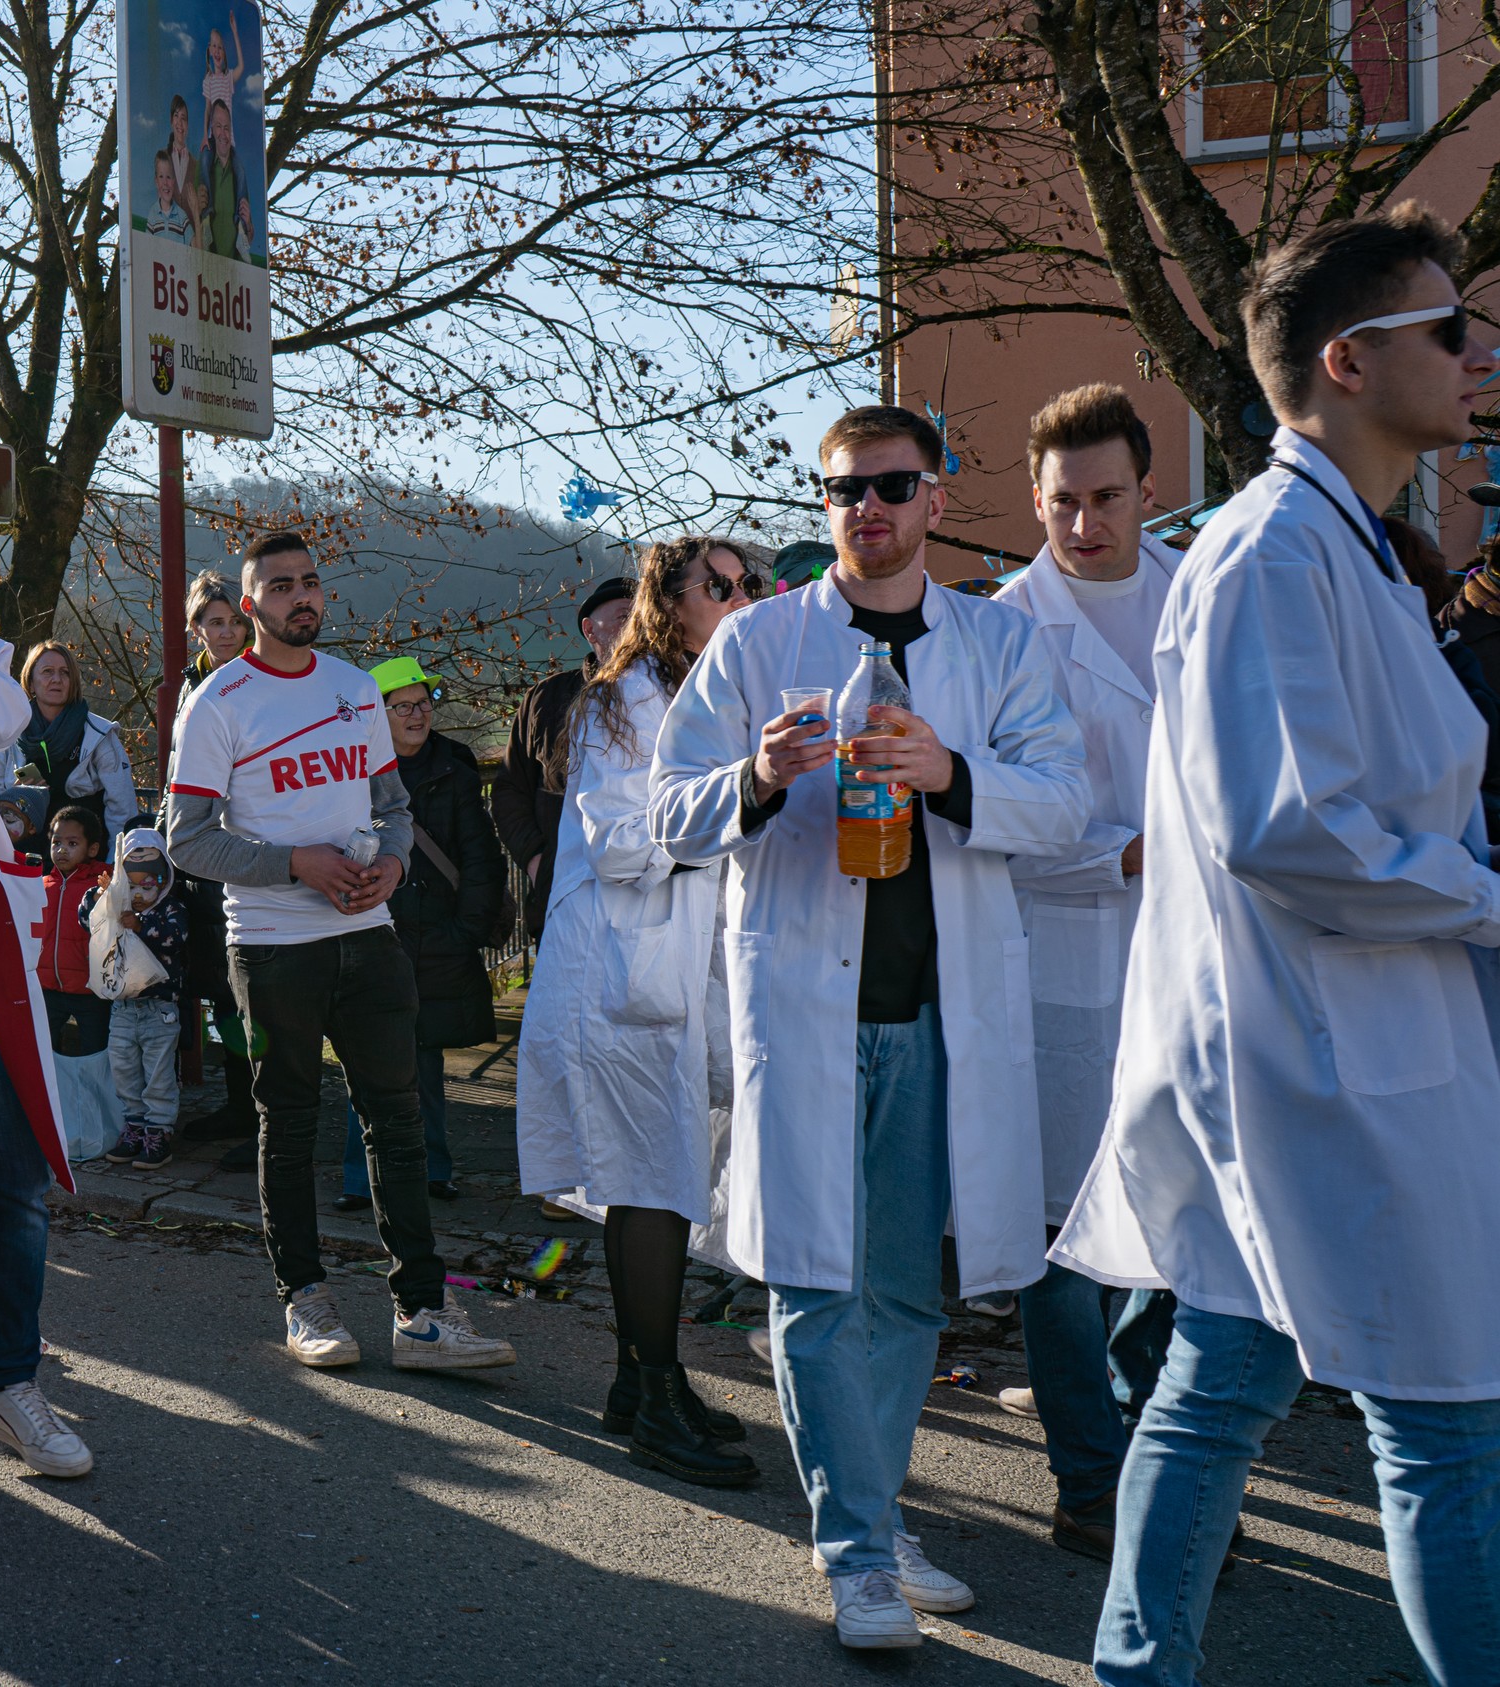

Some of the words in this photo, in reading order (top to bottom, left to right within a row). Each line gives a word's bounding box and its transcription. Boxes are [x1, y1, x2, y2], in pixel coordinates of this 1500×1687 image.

[153, 261, 189, 317] Bis
[197, 273, 252, 333] bald!
[181, 385, 194, 401] Wir
[218, 673, 253, 697] uhlsport
